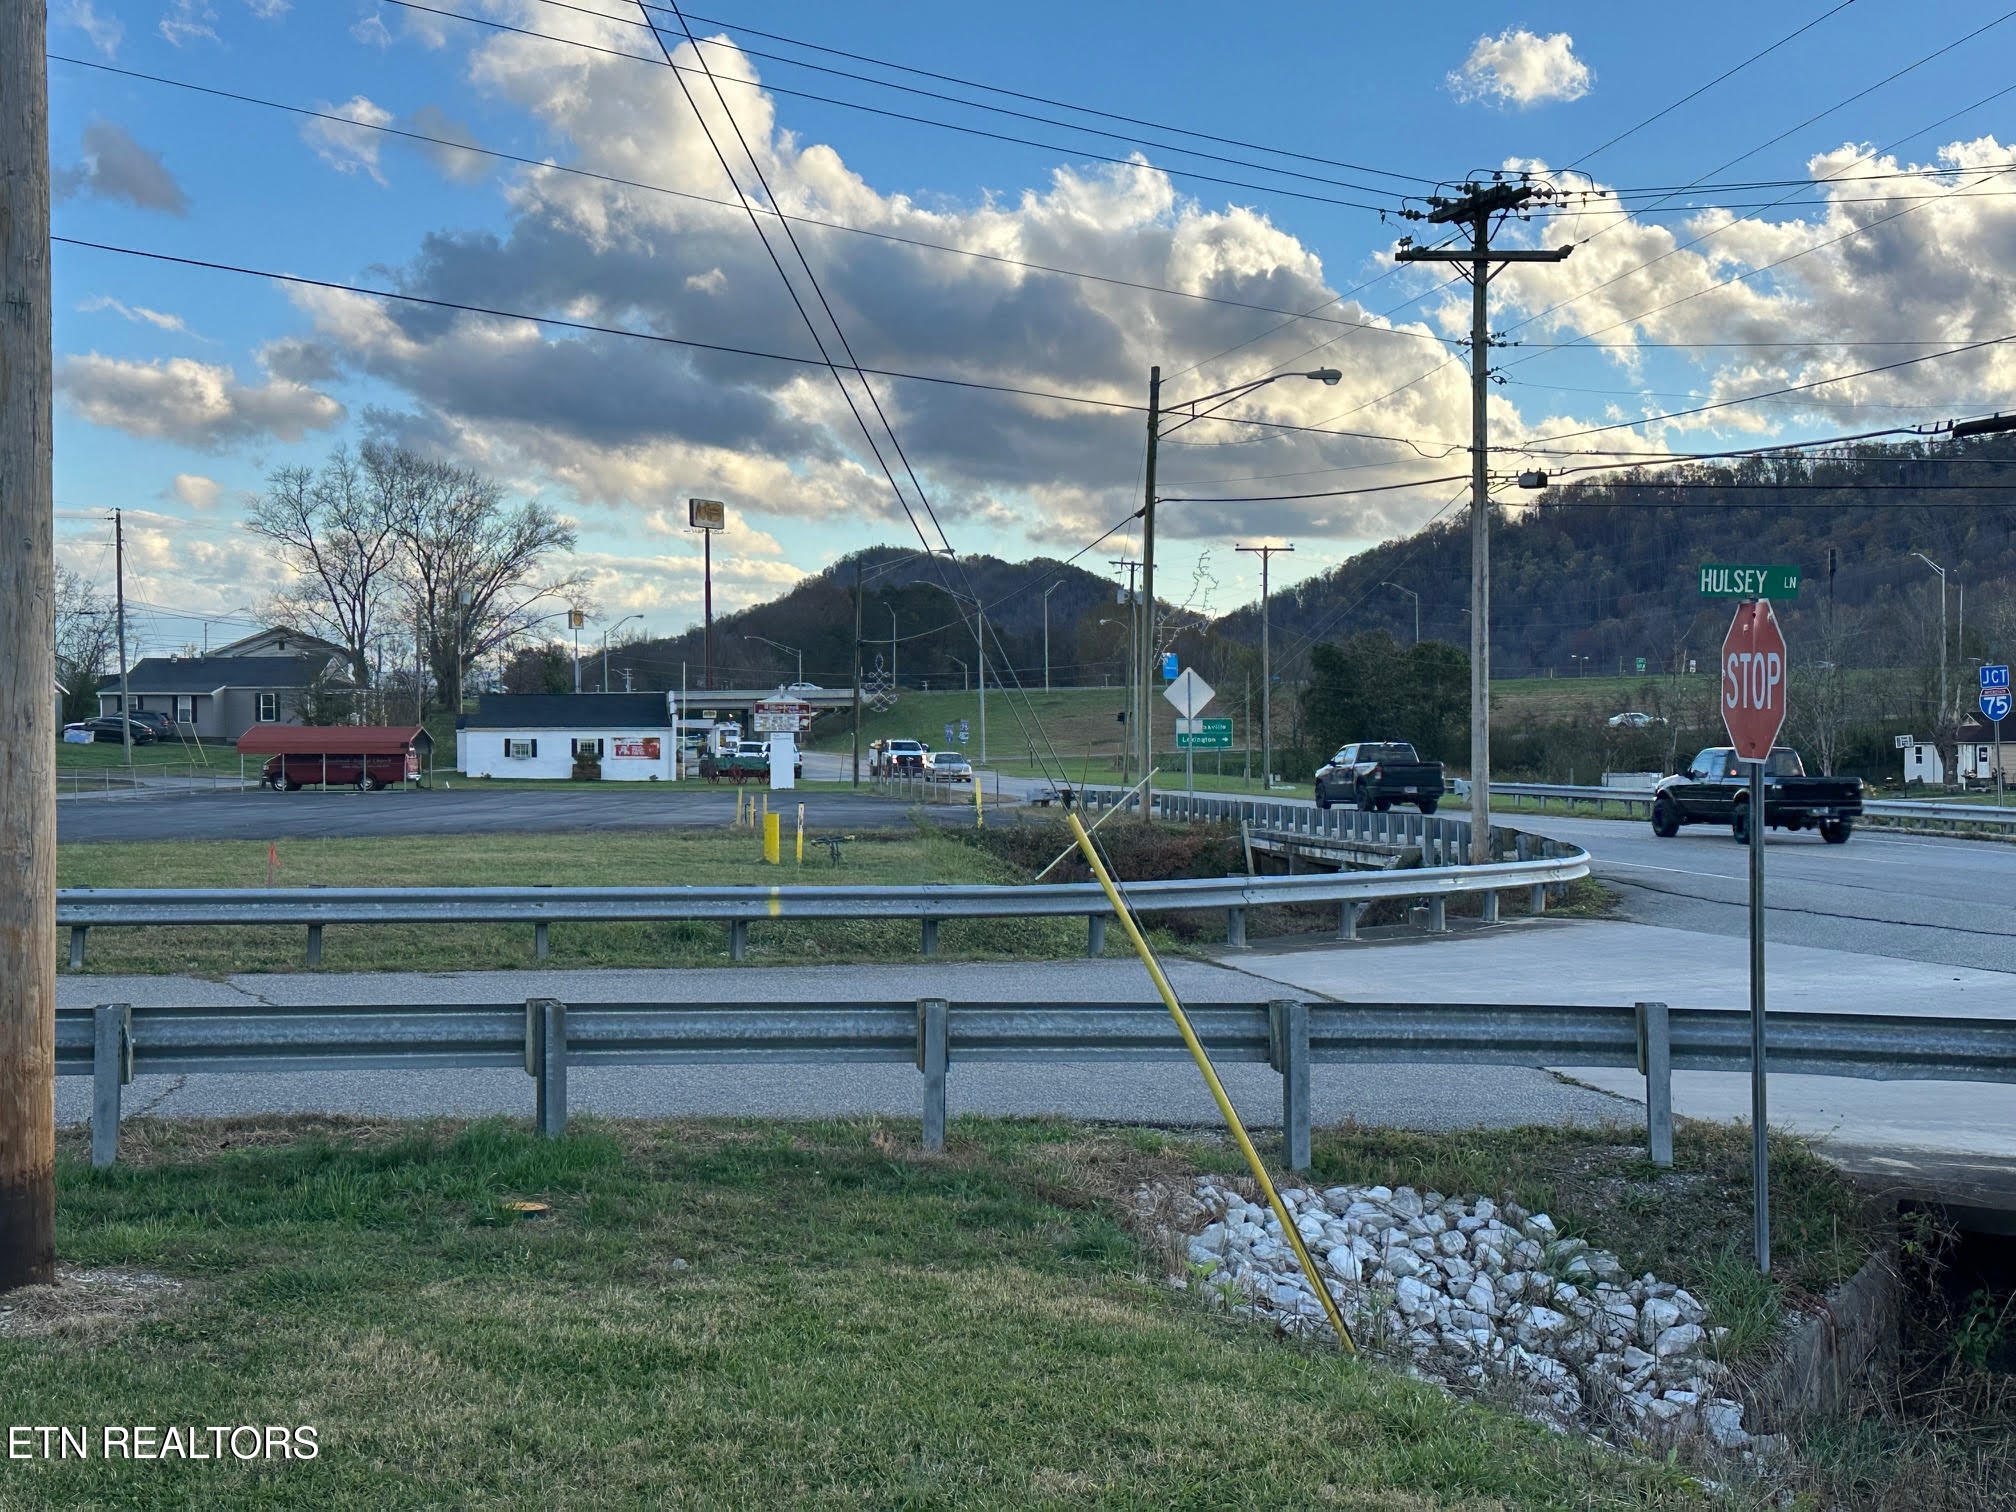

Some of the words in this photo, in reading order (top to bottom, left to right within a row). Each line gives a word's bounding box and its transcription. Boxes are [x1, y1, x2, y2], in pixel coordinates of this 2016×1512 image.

[1701, 569, 1768, 593] HULSEY
[1784, 576, 1797, 589] LN
[1726, 652, 1781, 710] STOP
[1982, 669, 2008, 684] JCT
[1983, 696, 2009, 715] 75
